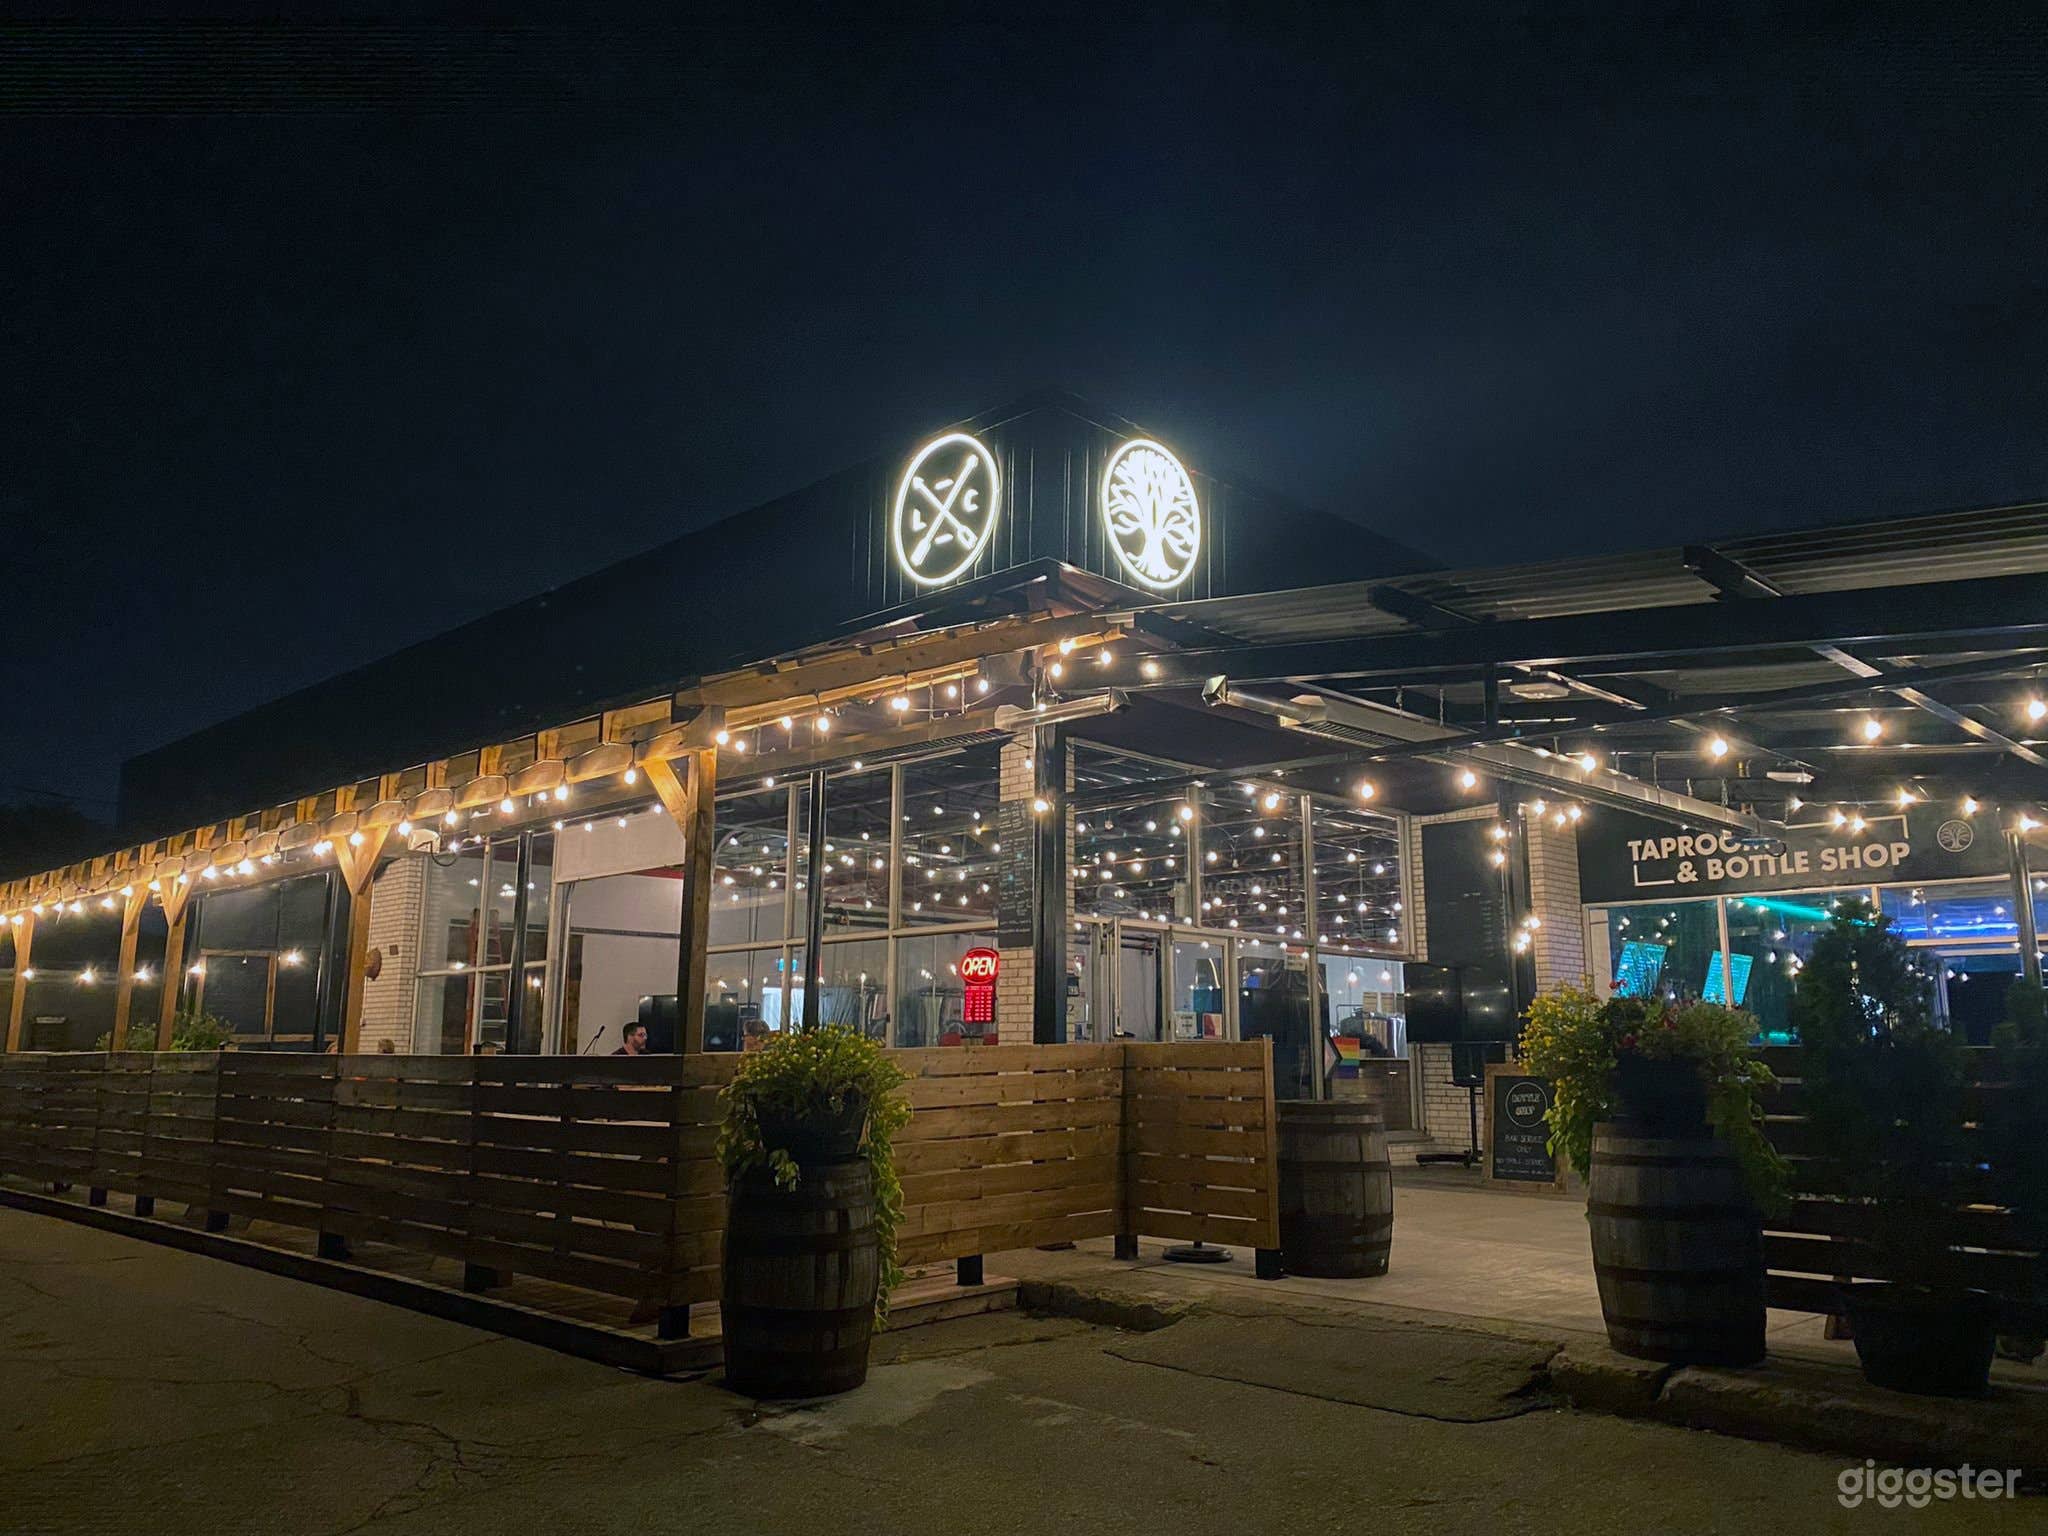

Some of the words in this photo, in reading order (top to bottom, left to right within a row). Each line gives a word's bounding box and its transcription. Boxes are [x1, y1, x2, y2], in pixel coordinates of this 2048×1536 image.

[1677, 861, 1699, 883] &
[1707, 850, 1810, 880] BOTTLE
[1820, 842, 1911, 872] SHOP
[962, 957, 996, 976] OPEN
